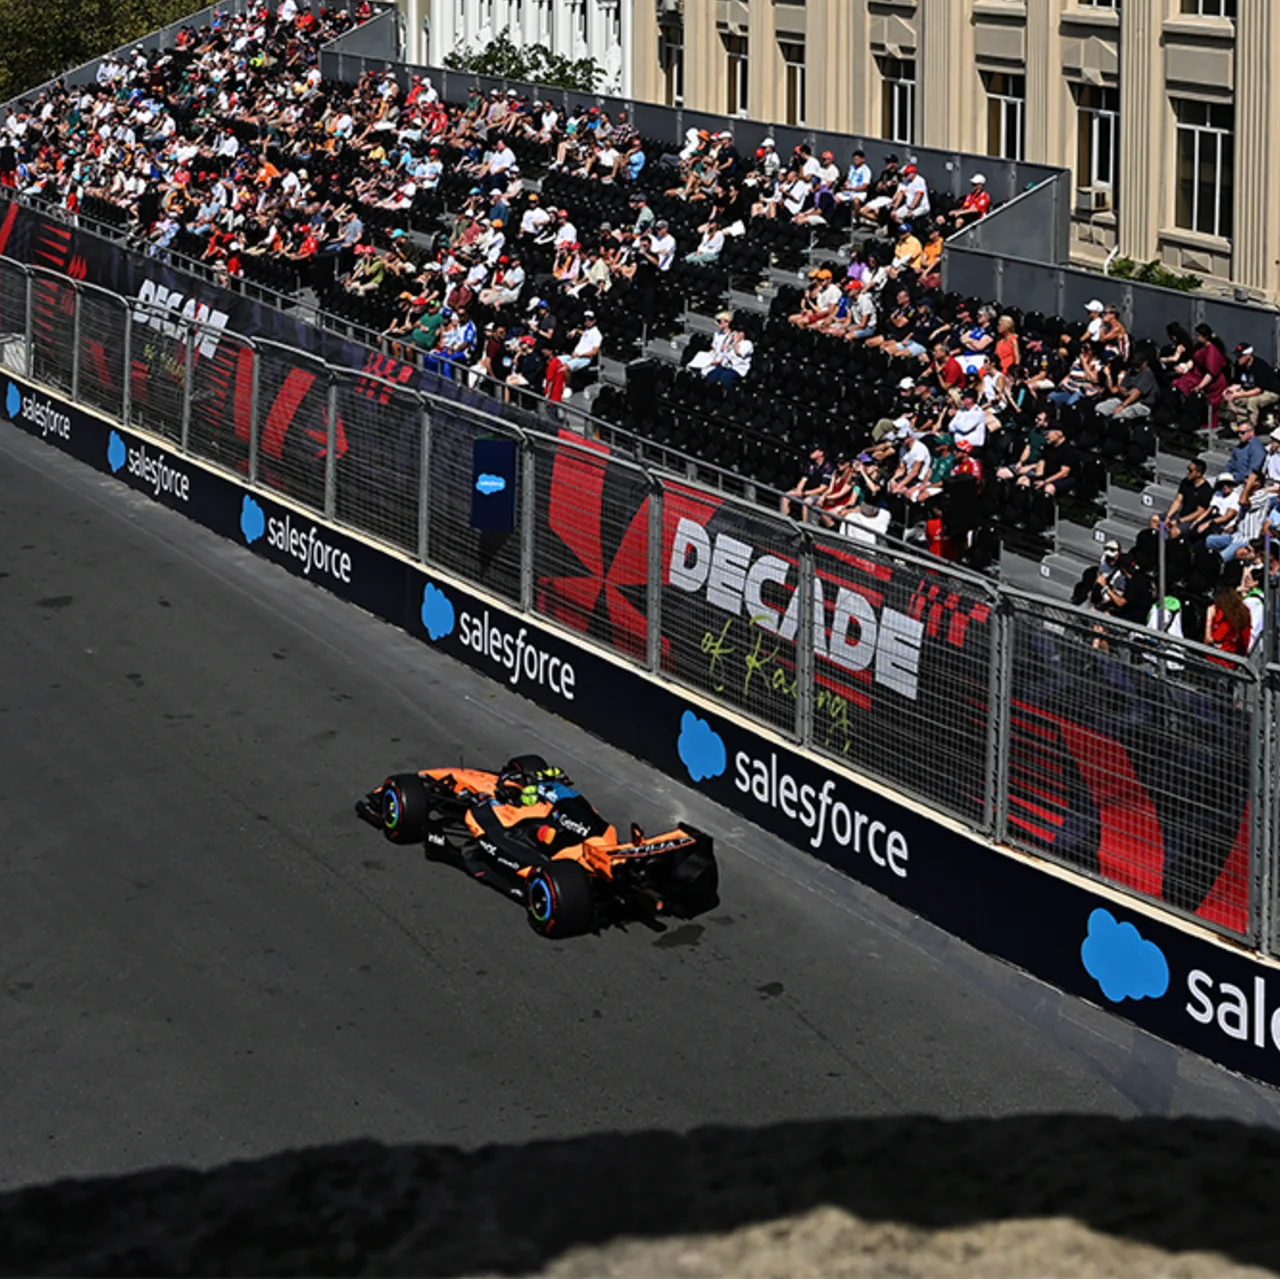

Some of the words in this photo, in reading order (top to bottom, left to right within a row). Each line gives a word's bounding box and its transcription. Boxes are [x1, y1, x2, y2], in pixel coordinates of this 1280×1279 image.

[22, 393, 70, 440] salesforce
[128, 445, 190, 501] salesforce
[267, 514, 351, 583] salesforce
[669, 517, 924, 700] DECADE
[459, 611, 575, 700] salesforce
[745, 615, 854, 752] Racng
[559, 813, 591, 837] Gemini
[735, 751, 908, 878] salesforce
